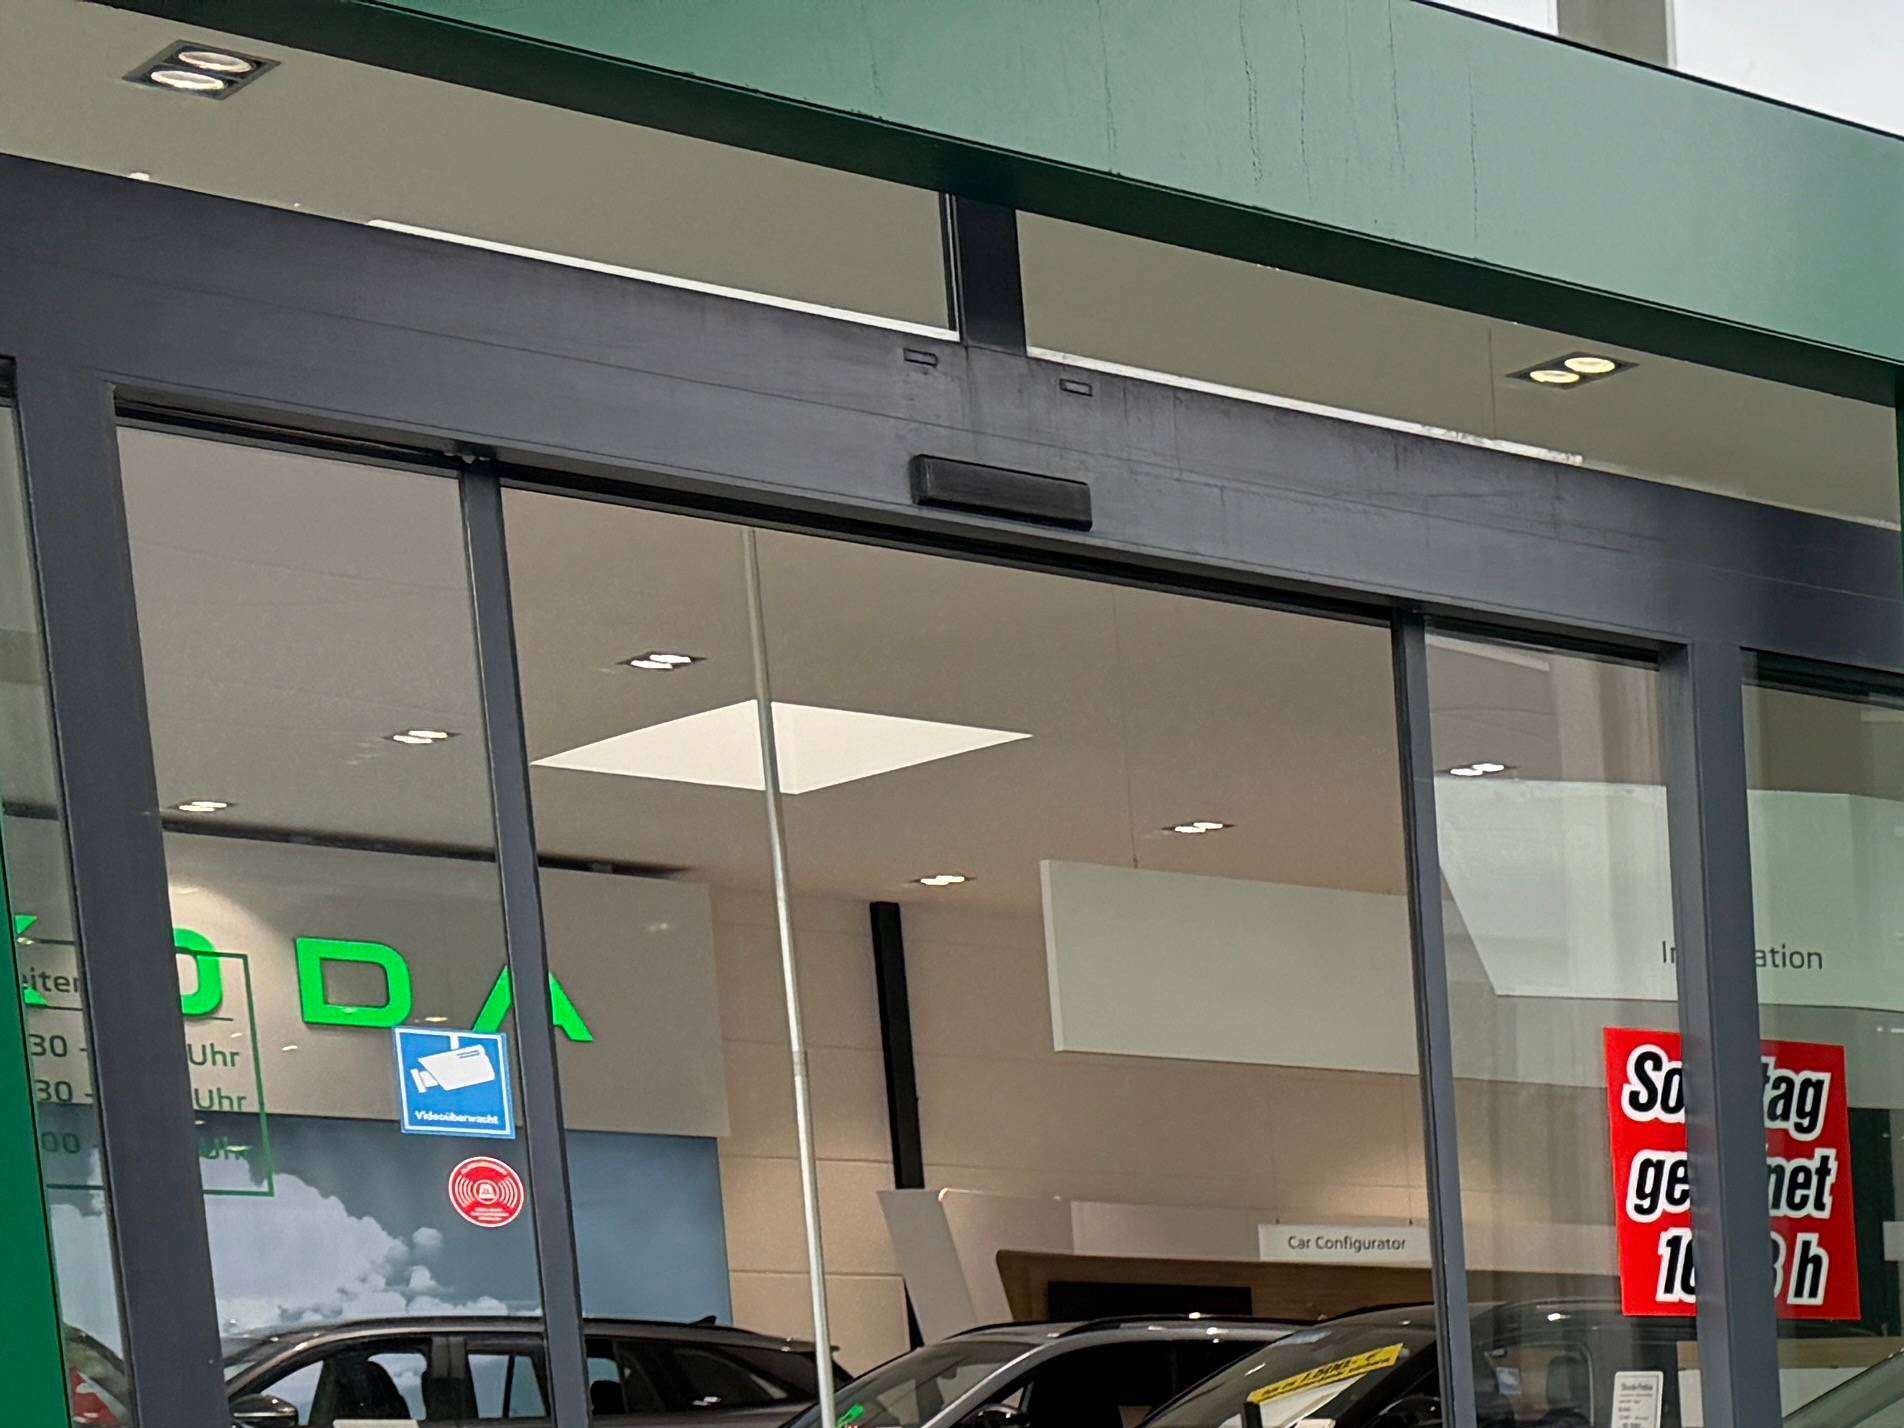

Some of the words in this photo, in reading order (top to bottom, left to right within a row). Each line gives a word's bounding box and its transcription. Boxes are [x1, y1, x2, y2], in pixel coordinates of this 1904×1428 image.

[186, 1042, 241, 1067] Uhr
[193, 1087, 248, 1112] Uhr
[1632, 1154, 1832, 1216] genet
[1287, 1234, 1312, 1250] Car
[1315, 1234, 1407, 1254] Configurator
